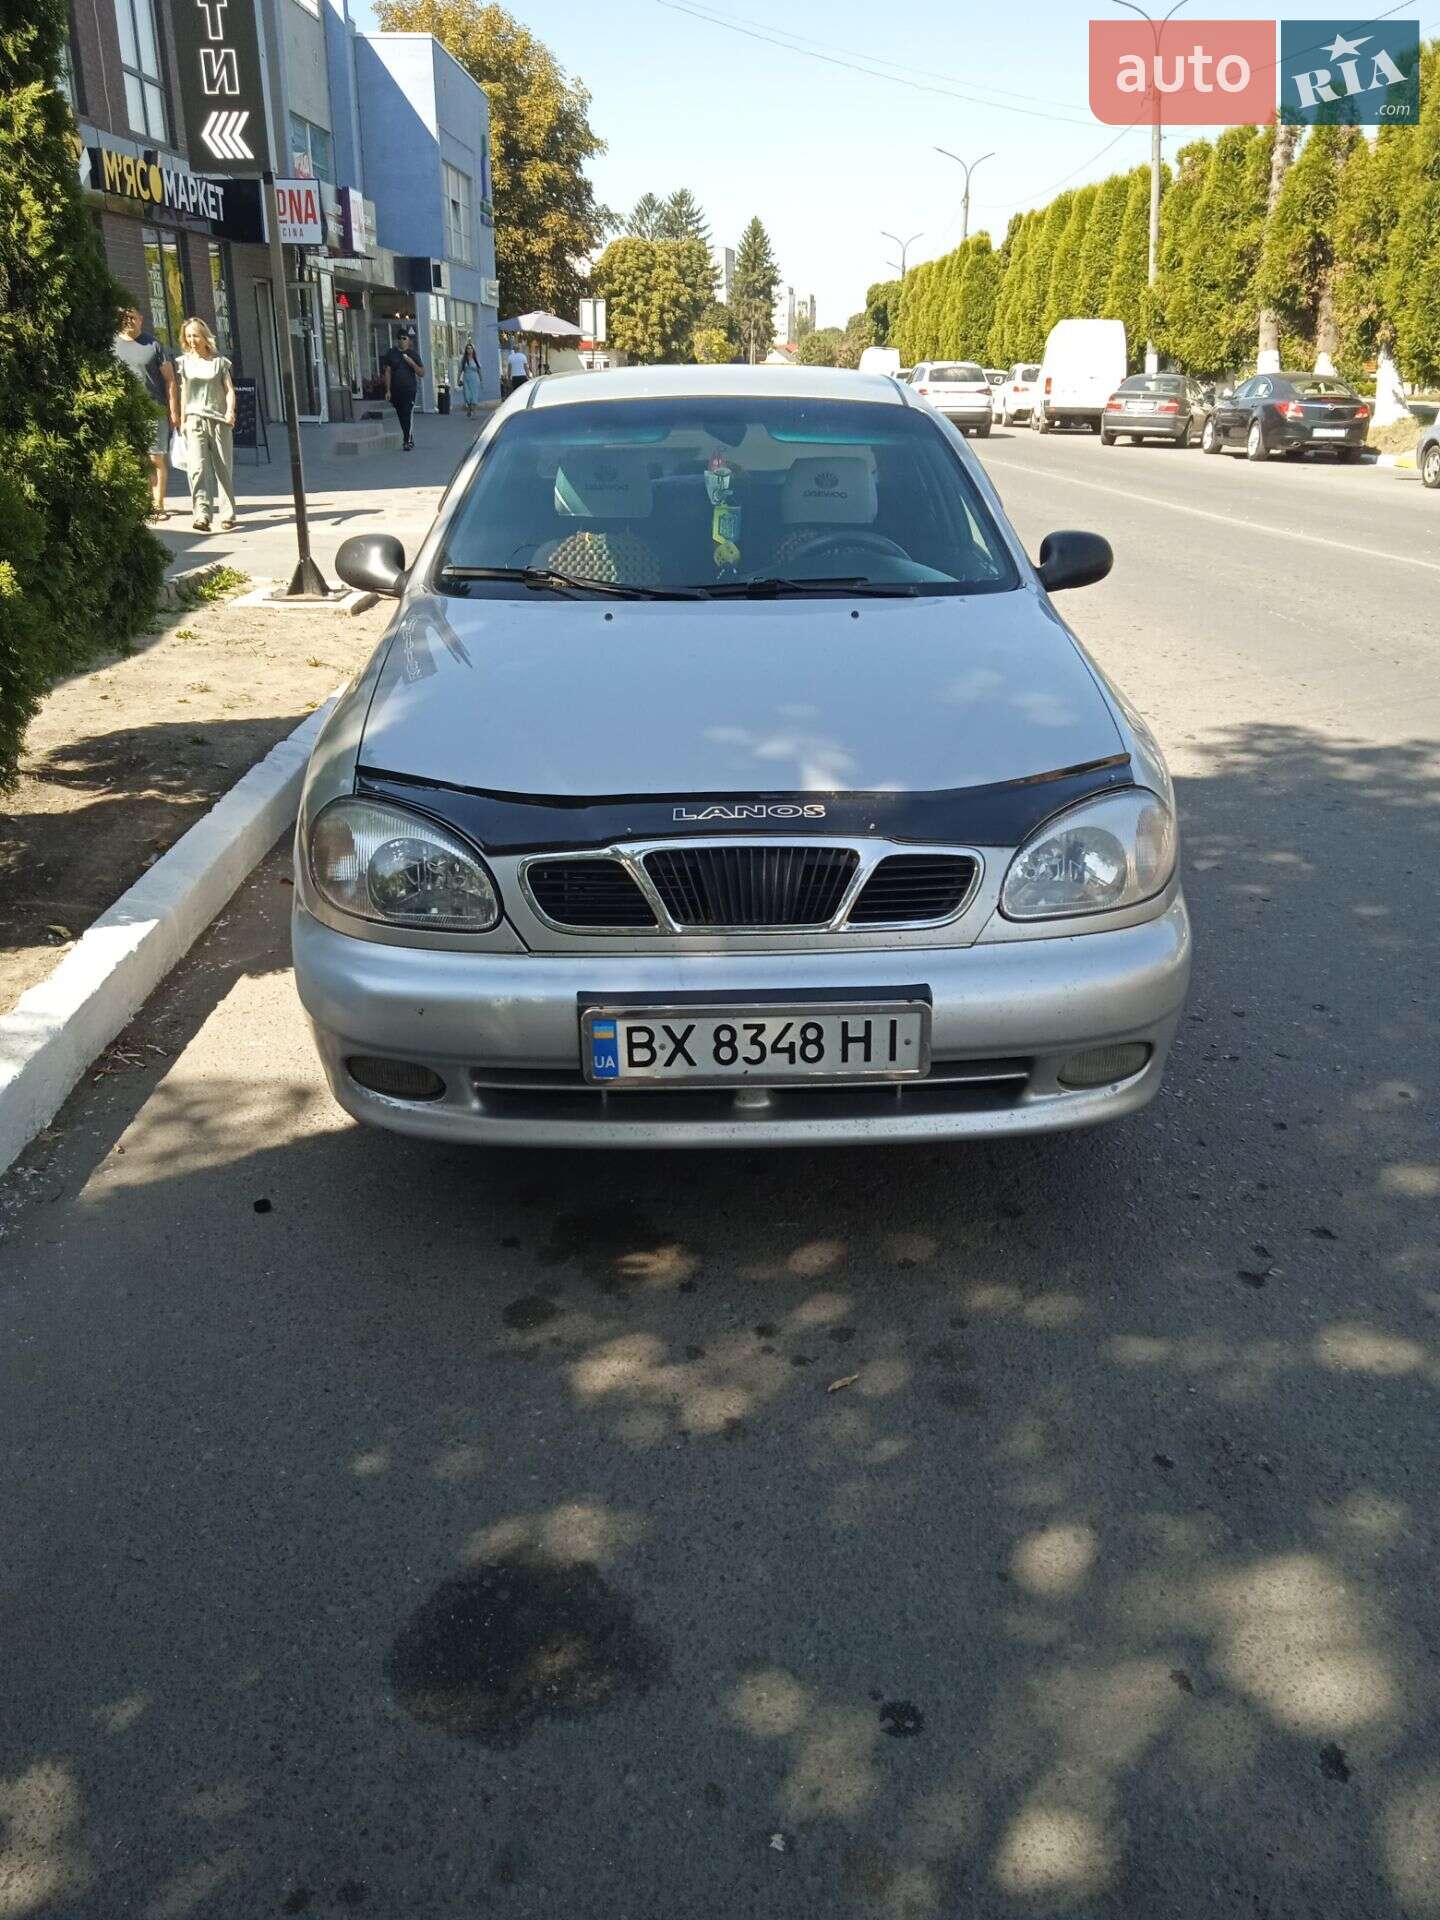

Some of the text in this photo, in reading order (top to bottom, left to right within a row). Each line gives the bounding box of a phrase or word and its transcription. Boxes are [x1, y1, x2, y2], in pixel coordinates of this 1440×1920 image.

[673, 804, 826, 822] LANOS
[626, 1025, 697, 1067] BX
[713, 1021, 826, 1065] 8348
[594, 1055, 616, 1069] UA
